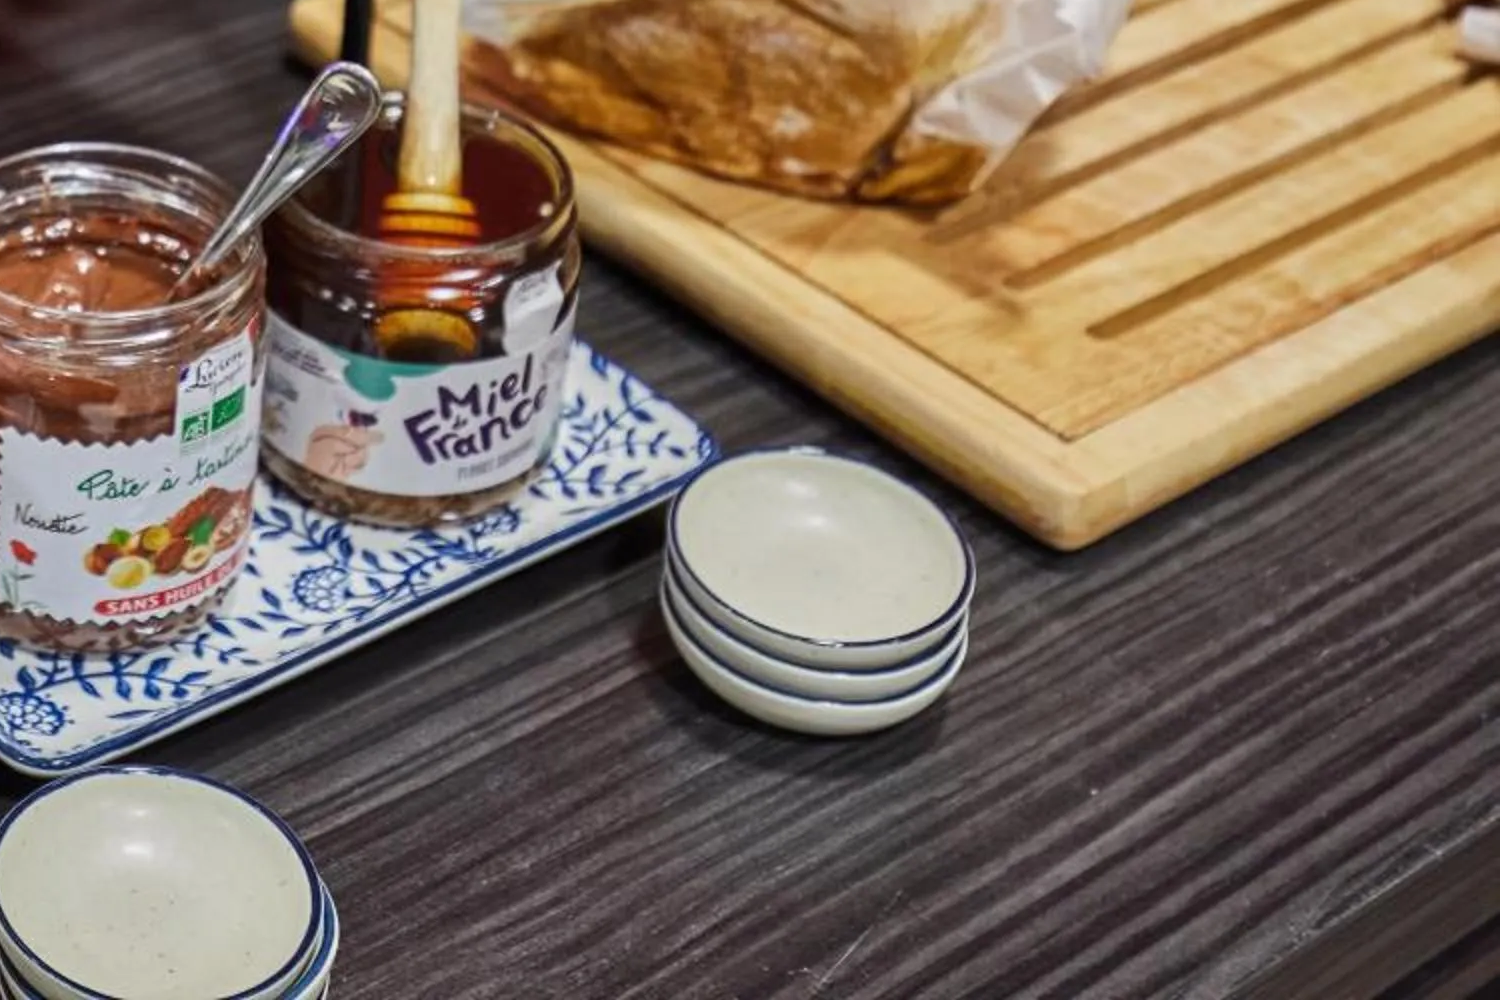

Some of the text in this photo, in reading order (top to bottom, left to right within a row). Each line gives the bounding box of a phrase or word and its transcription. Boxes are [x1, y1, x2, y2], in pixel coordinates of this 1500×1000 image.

[437, 353, 533, 421] Miel
[404, 384, 549, 466] France
[77, 469, 149, 501] Pâte
[157, 467, 181, 494] à
[105, 595, 161, 614] SANS
